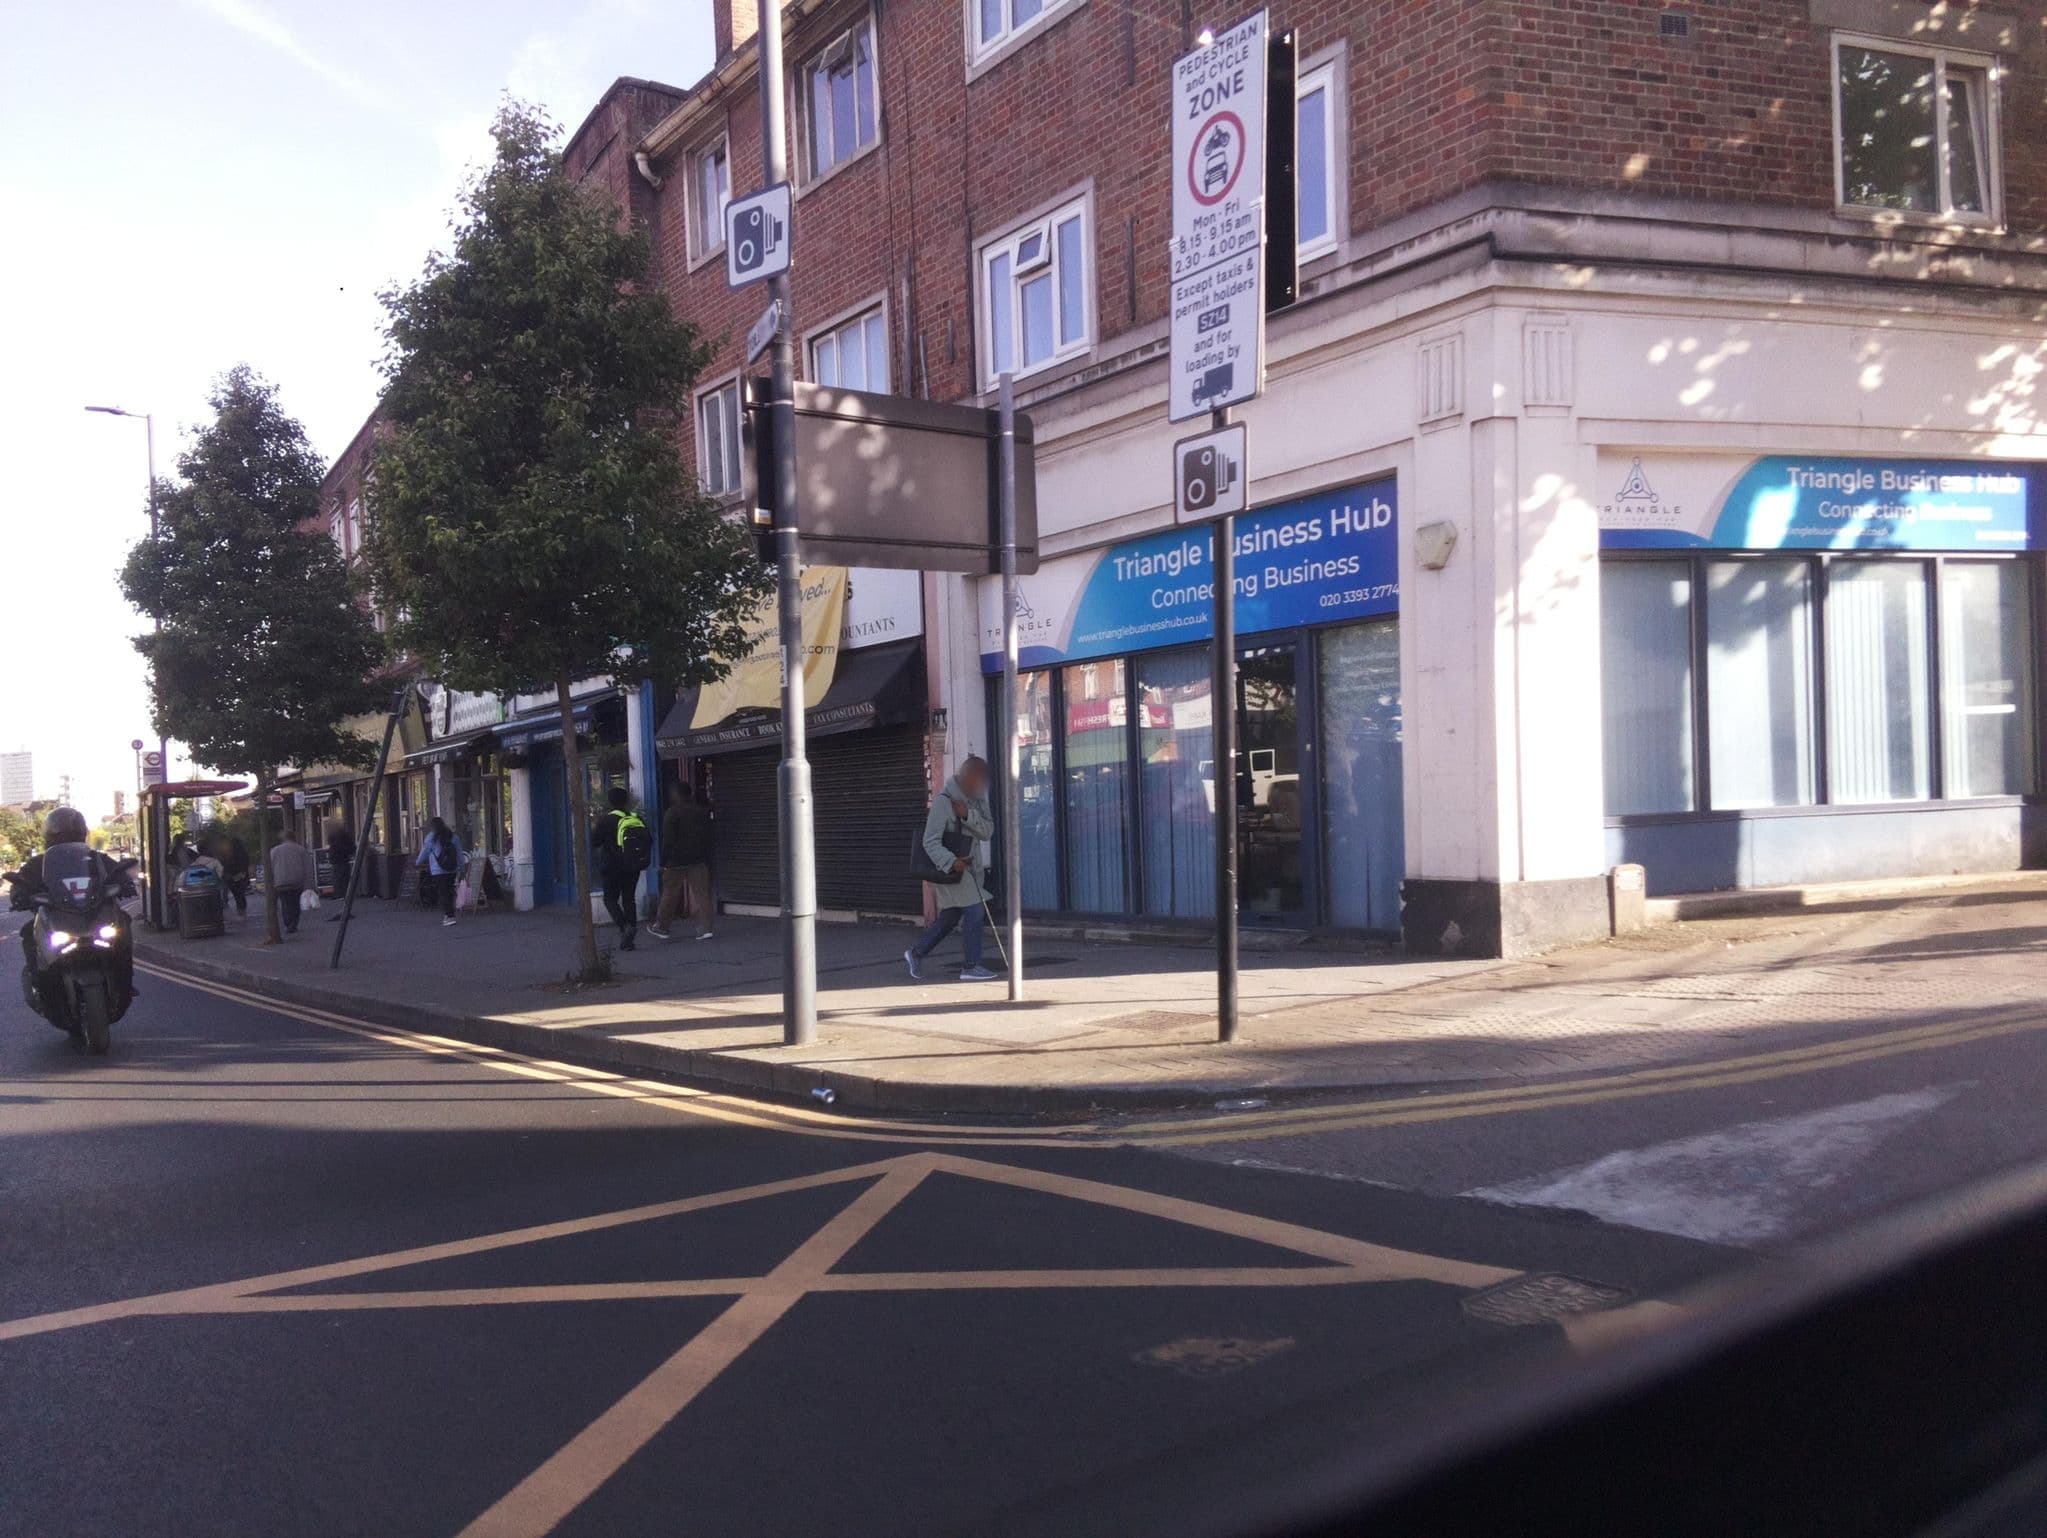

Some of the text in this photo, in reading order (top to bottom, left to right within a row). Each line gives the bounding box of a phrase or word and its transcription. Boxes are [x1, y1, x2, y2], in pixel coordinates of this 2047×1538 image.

[1179, 21, 1258, 80] PEDESTRIAN
[1185, 45, 1249, 93] and CYCLE
[1188, 69, 1245, 120] ZONE
[1179, 233, 1202, 254] 8.15
[1209, 218, 1233, 241] 9.15
[1235, 213, 1252, 230] am
[1192, 213, 1217, 233] Mon
[1225, 200, 1240, 217] Fri
[1175, 252, 1201, 274] 2.30
[1208, 236, 1236, 258] 4.00
[1238, 229, 1256, 248] pm
[1177, 257, 1255, 301] Except taxis &
[1175, 277, 1255, 321] permit holders
[1186, 343, 1241, 374] loading by
[1193, 329, 1232, 353] and for
[1787, 467, 1875, 494] Triangle
[1596, 505, 1680, 514] RIANGLE
[1113, 497, 1392, 583] Triangle siness Hub
[1152, 555, 1360, 609] Connecng Business
[1319, 592, 1341, 608] 020
[1343, 586, 1370, 605] 3393
[986, 618, 1052, 638] TRNGLE
[1077, 612, 1209, 644] www.trianglebusinesshub.co.uk
[719, 726, 751, 742] INSURANCE
